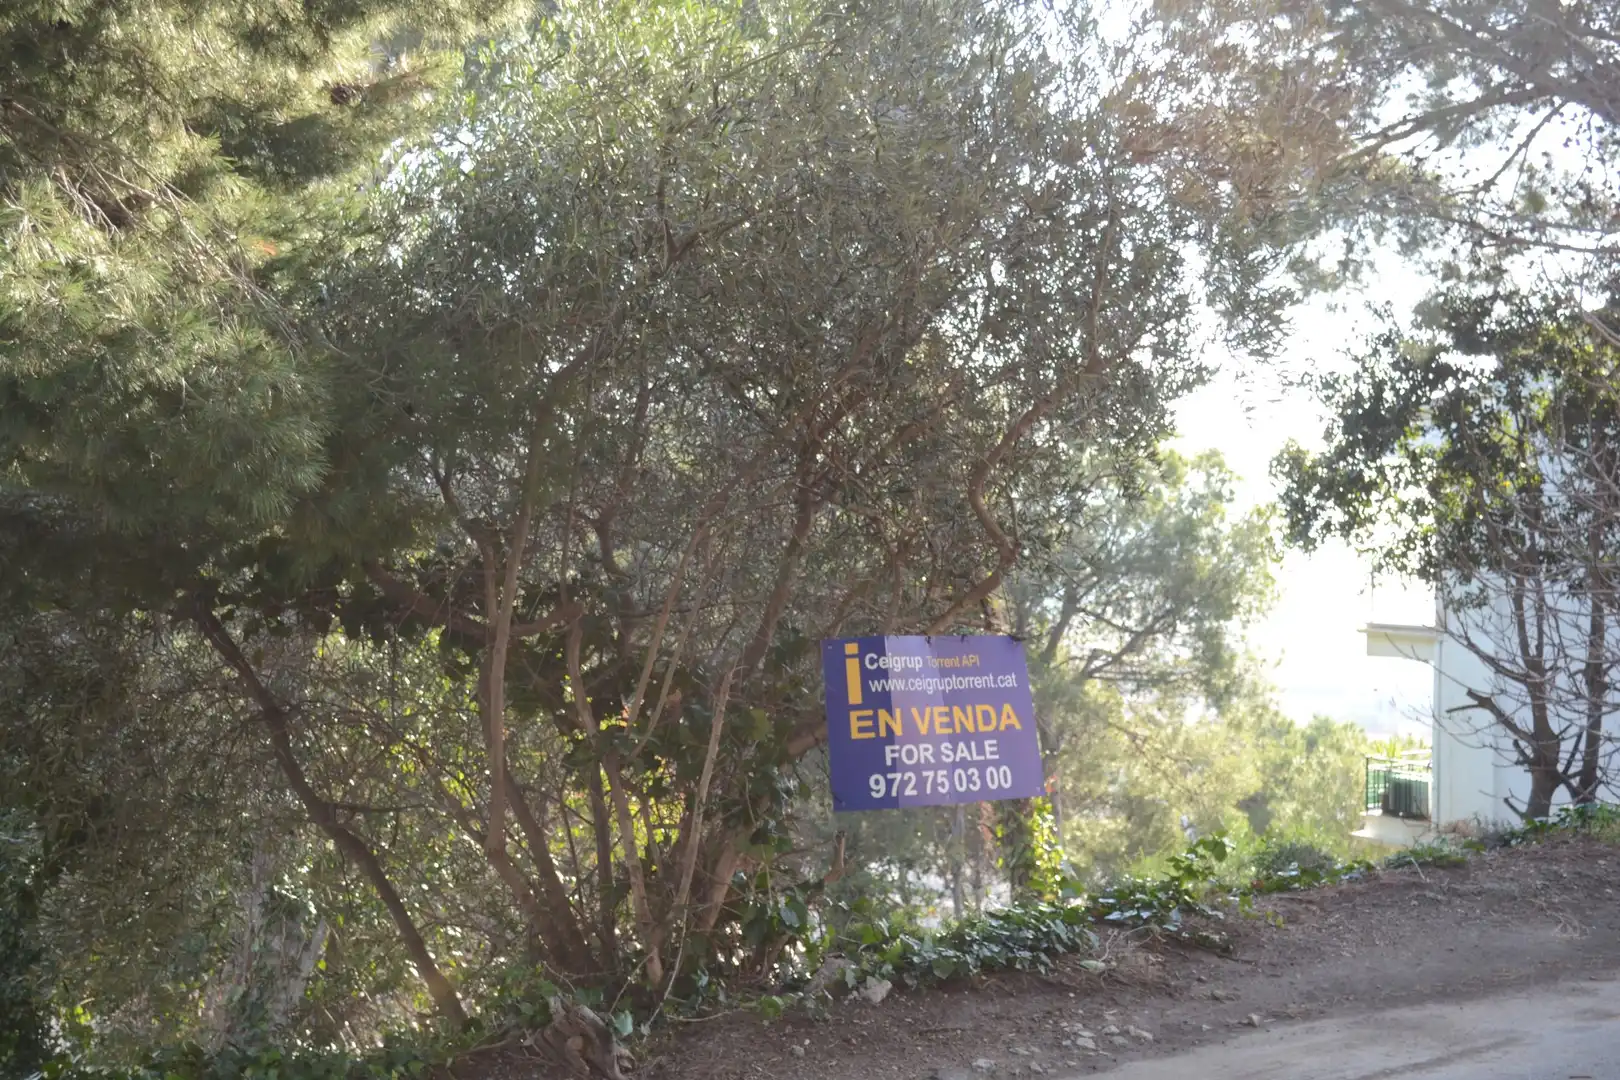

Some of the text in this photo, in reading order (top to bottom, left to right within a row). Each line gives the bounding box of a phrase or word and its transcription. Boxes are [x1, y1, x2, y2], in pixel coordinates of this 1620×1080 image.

[864, 652, 980, 672] Ceigrup Torrent API
[868, 672, 1018, 694] www.ceigruptorrent.cat
[850, 703, 1022, 740] EN VENDA
[884, 739, 1000, 766] FOR SALE
[868, 765, 1012, 799] 972 75 03 00
